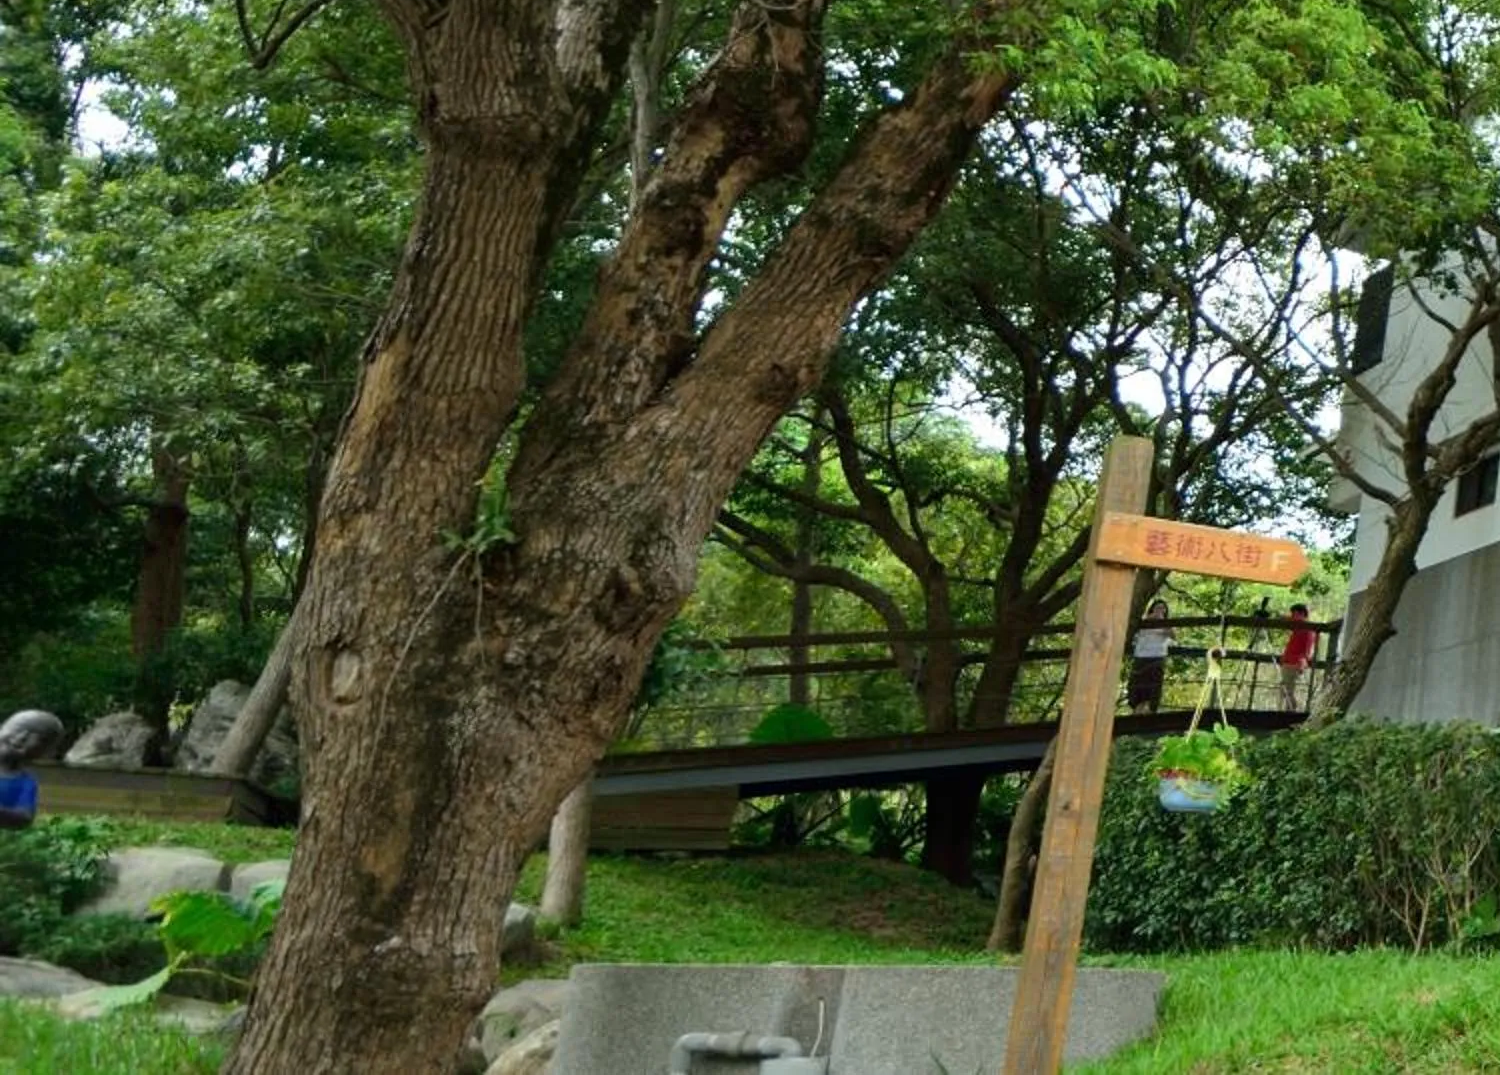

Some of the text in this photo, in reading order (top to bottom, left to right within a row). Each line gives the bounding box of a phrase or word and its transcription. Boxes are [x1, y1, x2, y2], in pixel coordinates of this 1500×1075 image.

[1146, 531, 1291, 572] 藝術八街 F
